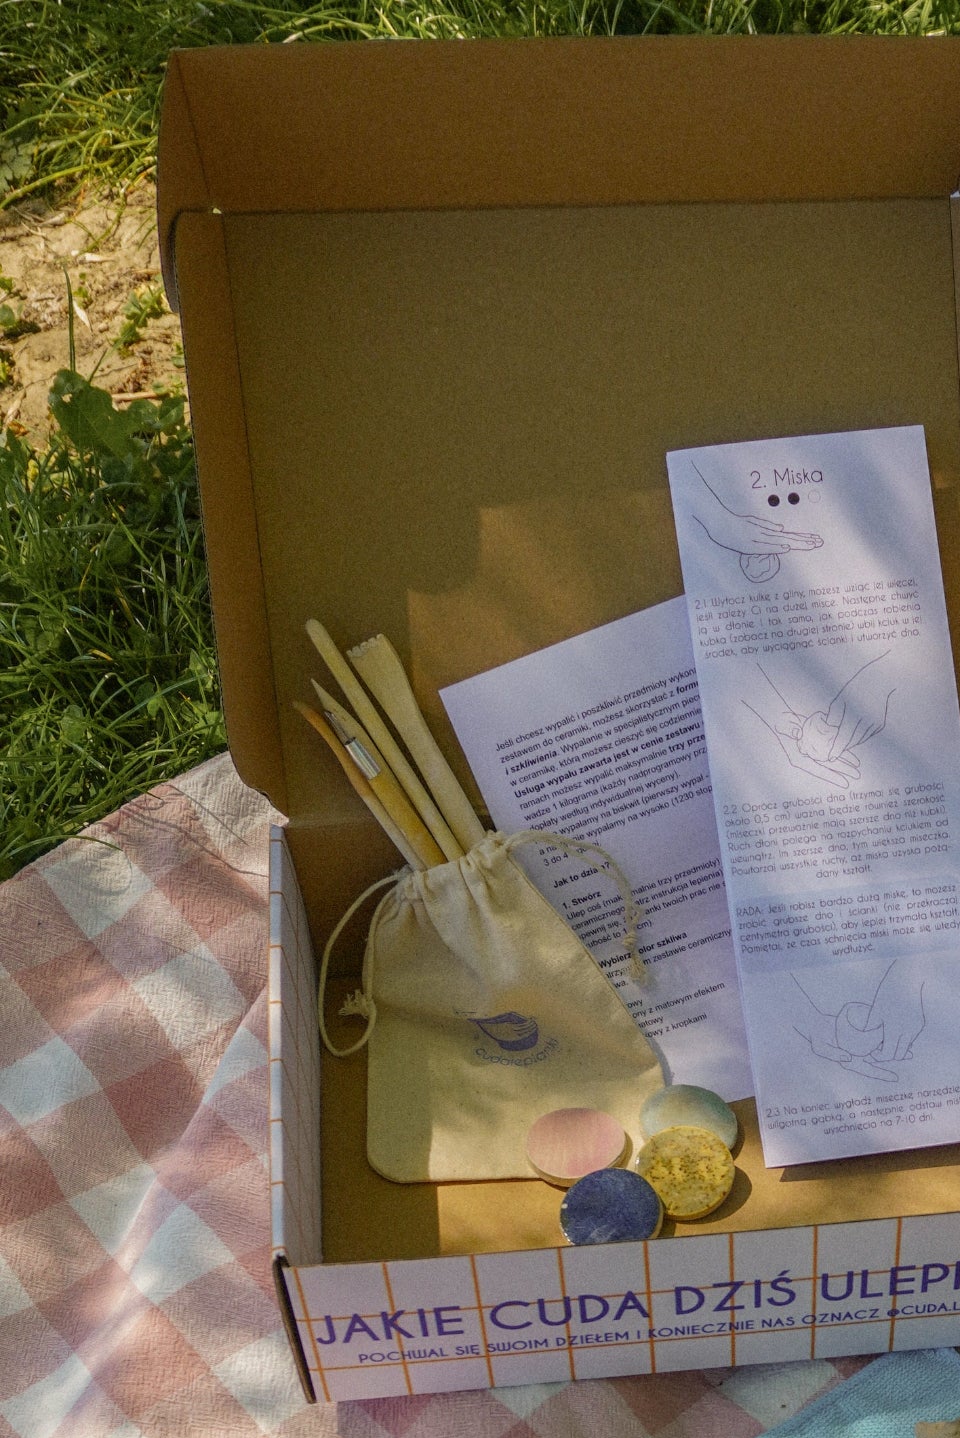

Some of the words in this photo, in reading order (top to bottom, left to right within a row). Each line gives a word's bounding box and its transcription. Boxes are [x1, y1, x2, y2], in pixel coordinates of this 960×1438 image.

[749, 469, 766, 490] 2.
[773, 462, 823, 487] Miska
[494, 737, 514, 751] Jeśli
[514, 725, 544, 743] chcesz
[544, 713, 576, 733] wypalić
[579, 695, 623, 719] poszkliwić
[622, 677, 668, 703] przedmioty
[668, 666, 697, 685] wykon
[499, 741, 541, 763] zestawem
[541, 736, 554, 747] do
[591, 708, 624, 727] możesz
[624, 691, 668, 716] skorzystać
[559, 730, 604, 755] Wypalanie
[612, 700, 681, 734] specjalistycznym
[545, 768, 578, 788] wypału
[578, 754, 612, 774] zawarta
[612, 748, 630, 762] jest
[639, 734, 664, 750] cenie
[558, 753, 581, 769] którą
[580, 740, 613, 759] możesz
[613, 728, 645, 748] cieszyć
[518, 792, 550, 810] ramach
[550, 780, 583, 798] możesz
[582, 767, 615, 787] wypalić
[614, 747, 668, 775] maksymalnie
[667, 740, 686, 754] trzy
[523, 805, 552, 822] wadze
[558, 787, 599, 810] kilograma
[599, 776, 627, 794] (każdy
[627, 750, 692, 783] nadprogramowy
[558, 814, 600, 837] wypalamy
[611, 798, 640, 815] biskwit
[679, 773, 705, 790] wypał
[559, 804, 589, 823] według
[589, 783, 644, 811] indywidualnej
[585, 817, 626, 840] wypalamy
[638, 800, 670, 819] wysoko
[670, 790, 695, 807] (1230
[549, 853, 562, 864] do
[551, 876, 569, 888] Jak
[566, 907, 586, 922] Ulep
[657, 875, 673, 888] trzy
[570, 904, 626, 932] ceramicznego
[650, 881, 689, 902] instrukcja
[571, 889, 602, 906] Stwórz
[689, 887, 708, 900] prac
[651, 943, 686, 962] zestawie
[655, 930, 687, 948] szkliwa
[654, 993, 693, 1014] matowym
[692, 981, 725, 998] efektem
[671, 1011, 708, 1032] kropkami
[316, 1305, 465, 1345] JAKIE
[489, 1290, 650, 1330] CUDA
[674, 1269, 797, 1315] DZIŚ
[358, 1347, 449, 1364] POCHWAL
[455, 1344, 480, 1356] SIĘ
[487, 1338, 549, 1353] SWOIM
[556, 1330, 630, 1347] DZIEŁEM
[636, 1330, 641, 1340] I
[648, 1318, 755, 1339] KONIECZNIE
[760, 1316, 796, 1330] NAS
[801, 1308, 880, 1325] OZNACZ
